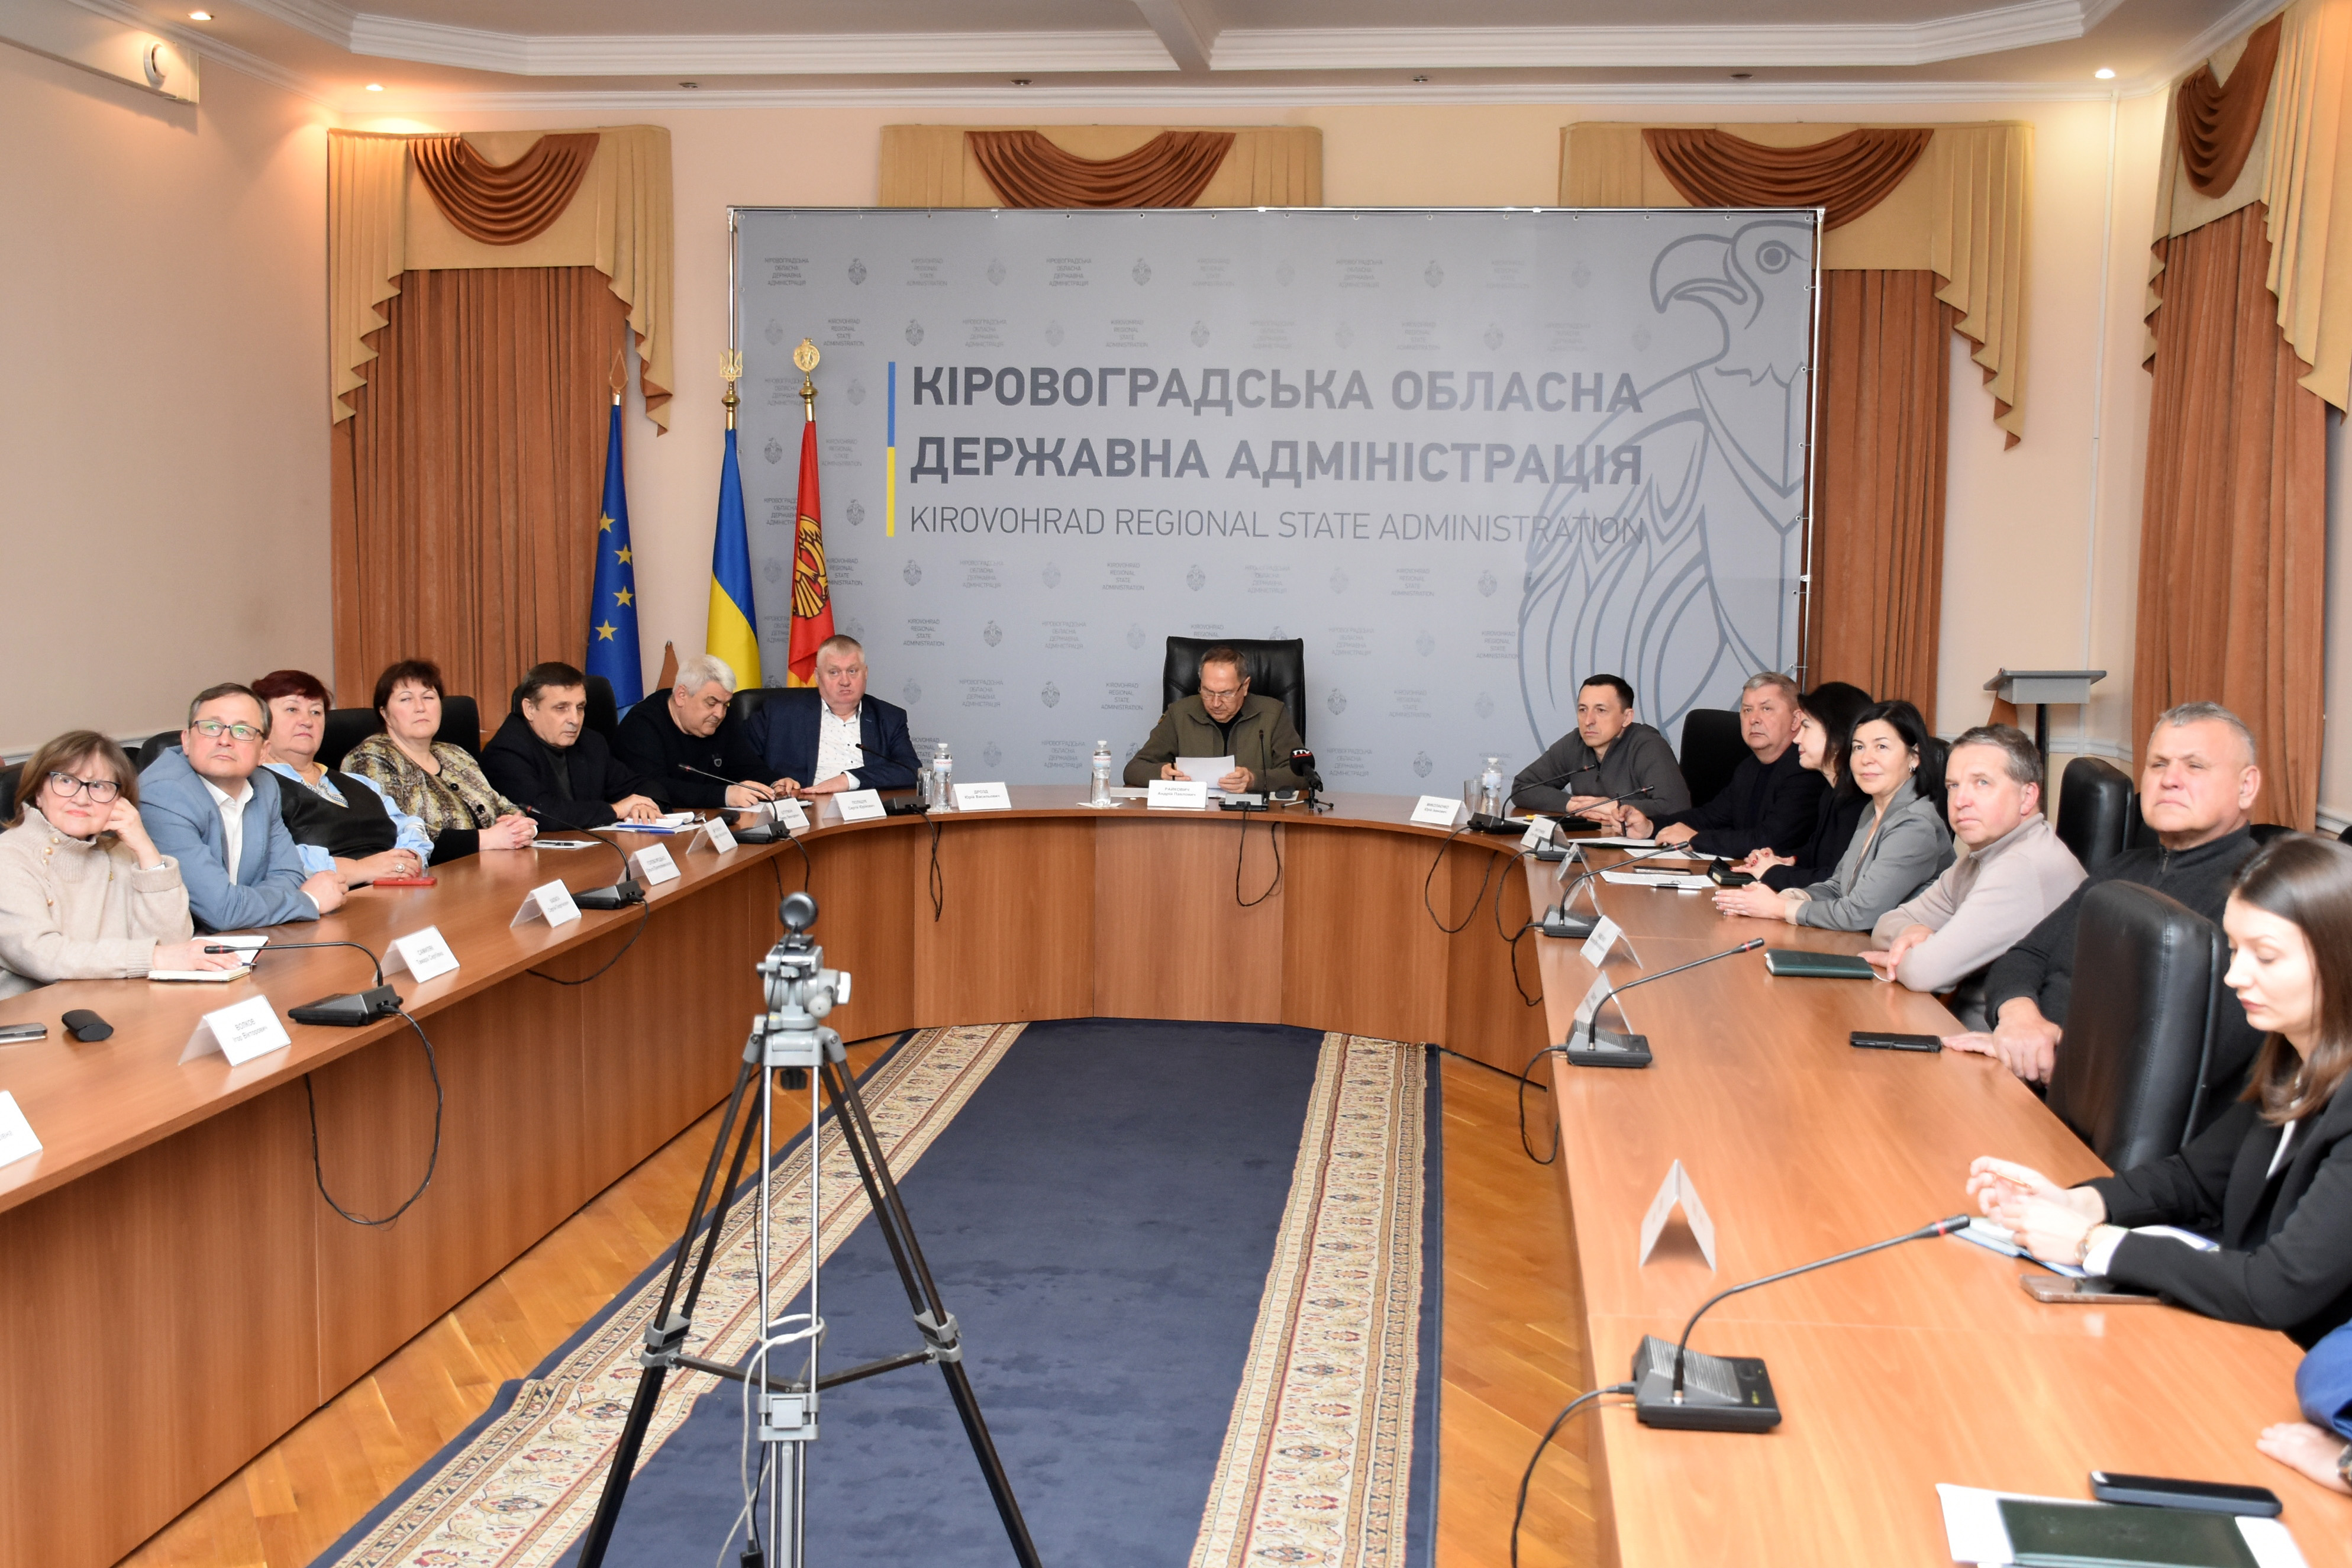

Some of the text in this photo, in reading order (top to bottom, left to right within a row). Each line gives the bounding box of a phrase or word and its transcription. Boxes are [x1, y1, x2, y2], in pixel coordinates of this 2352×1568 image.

[914, 366, 1643, 417] КІРОВОГРАДСЬКА ОБЛАСНА
[910, 437, 1641, 492] ДЕРЖАВНА АДМІНІСТРАЦІЯ
[911, 506, 1643, 544] KIROVOHRAD REGIONAL STATE ADMINISTRATION
[235, 1018, 256, 1031] ВОЛКОВ
